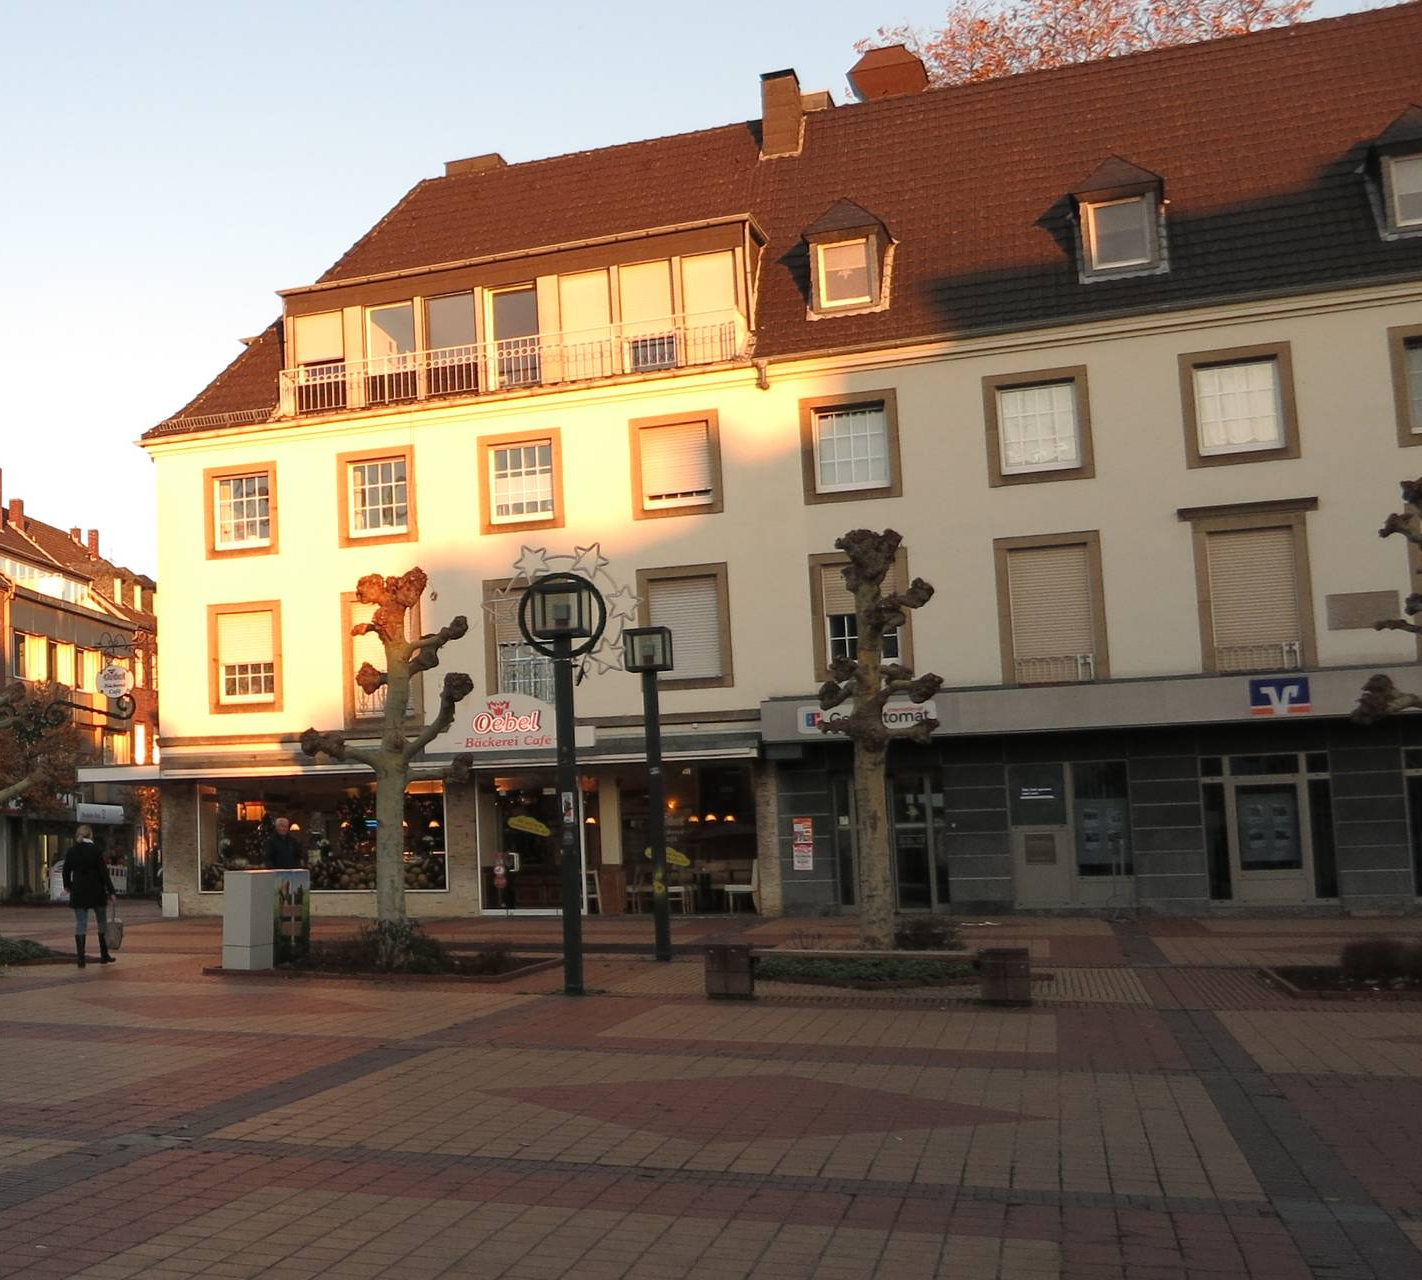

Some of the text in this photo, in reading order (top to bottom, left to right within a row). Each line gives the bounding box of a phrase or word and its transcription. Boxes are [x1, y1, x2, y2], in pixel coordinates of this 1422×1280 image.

[473, 710, 541, 734] Oebel
[830, 711, 929, 727] Gtomat
[465, 736, 518, 748] Bäckerei
